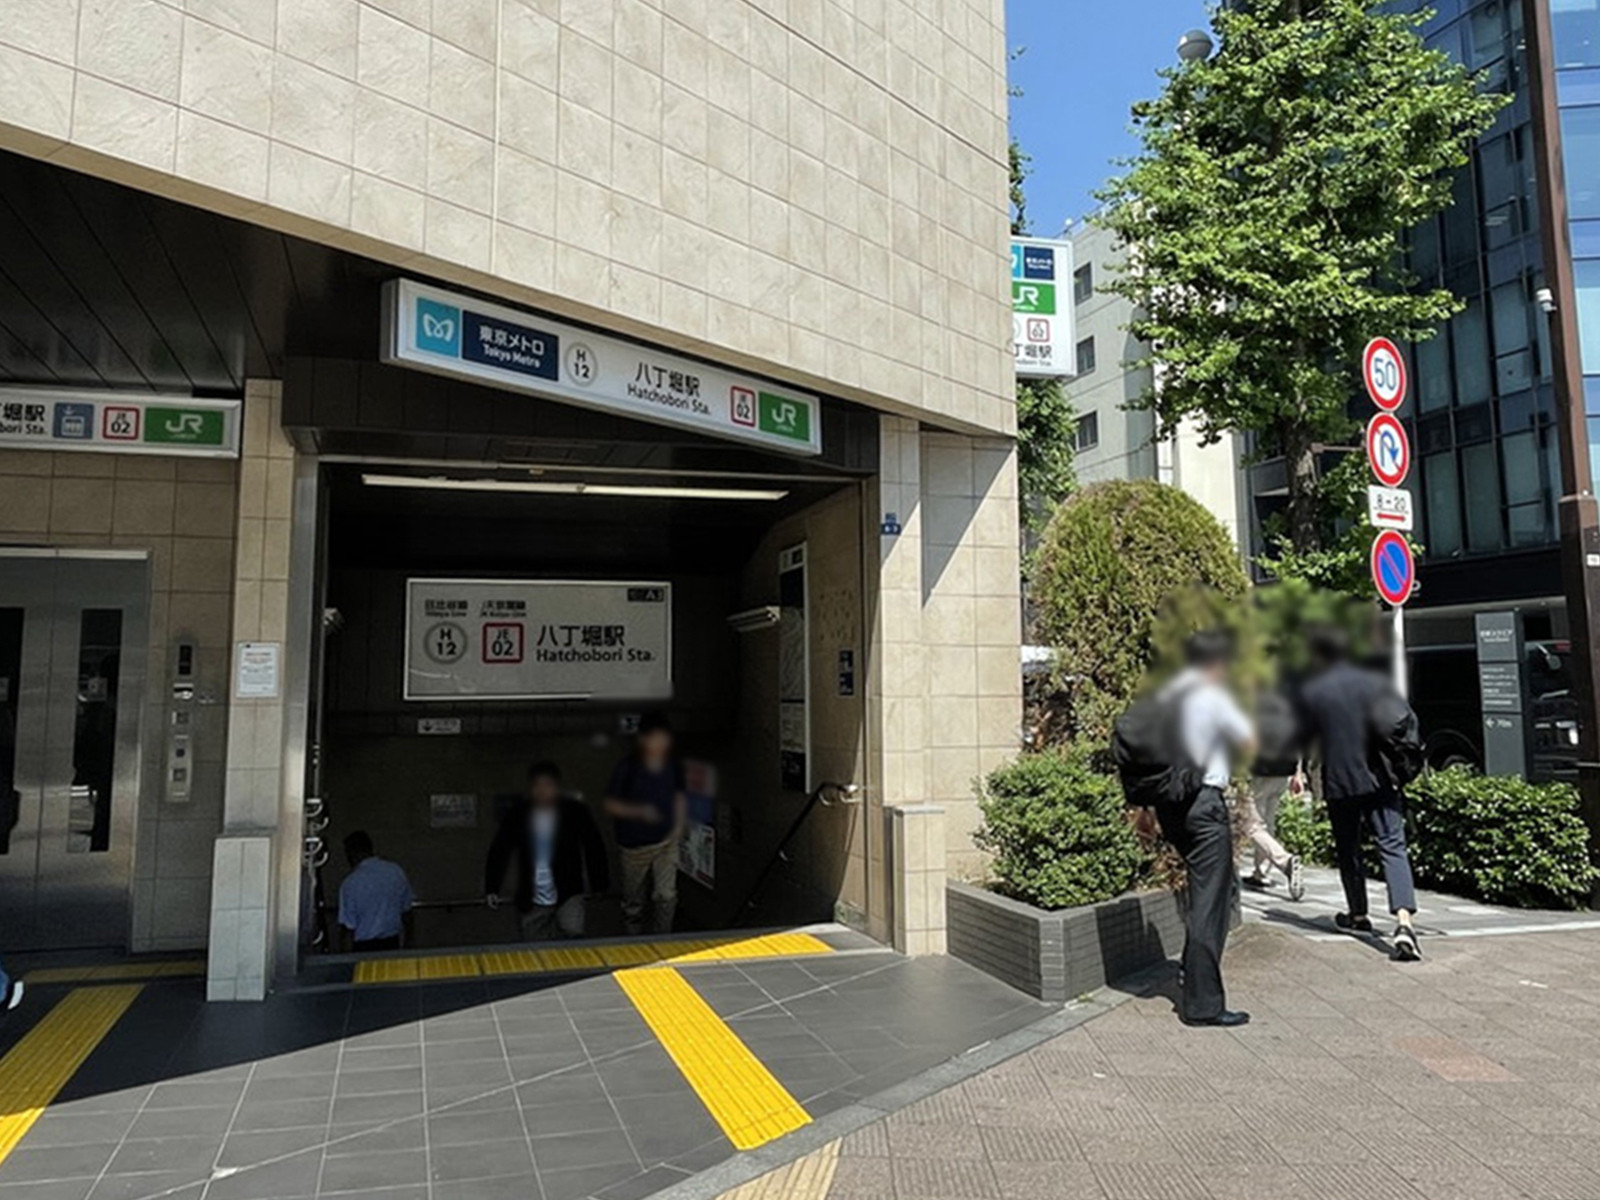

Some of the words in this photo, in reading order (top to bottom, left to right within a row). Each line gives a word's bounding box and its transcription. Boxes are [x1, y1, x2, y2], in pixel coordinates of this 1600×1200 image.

[479, 325, 545, 356] 東京メトロ
[482, 343, 512, 363] Tokyo
[512, 351, 542, 369] Metro
[576, 349, 587, 363] H
[573, 363, 591, 379] 12
[634, 361, 702, 398] 八丁堀駅
[1373, 357, 1398, 391] 50
[626, 383, 691, 410] Hatchobori
[691, 398, 712, 416] Sta.
[736, 403, 750, 420] 02
[771, 402, 797, 427] JR
[25, 423, 48, 435] Sta.
[110, 421, 131, 434] 02
[165, 413, 203, 434] JR
[440, 628, 452, 641] H
[536, 624, 626, 648] 八丁堀駅
[437, 641, 457, 656] 12
[491, 640, 514, 657] 02
[536, 648, 623, 663] Hatchobori
[627, 649, 657, 663] Sta.
